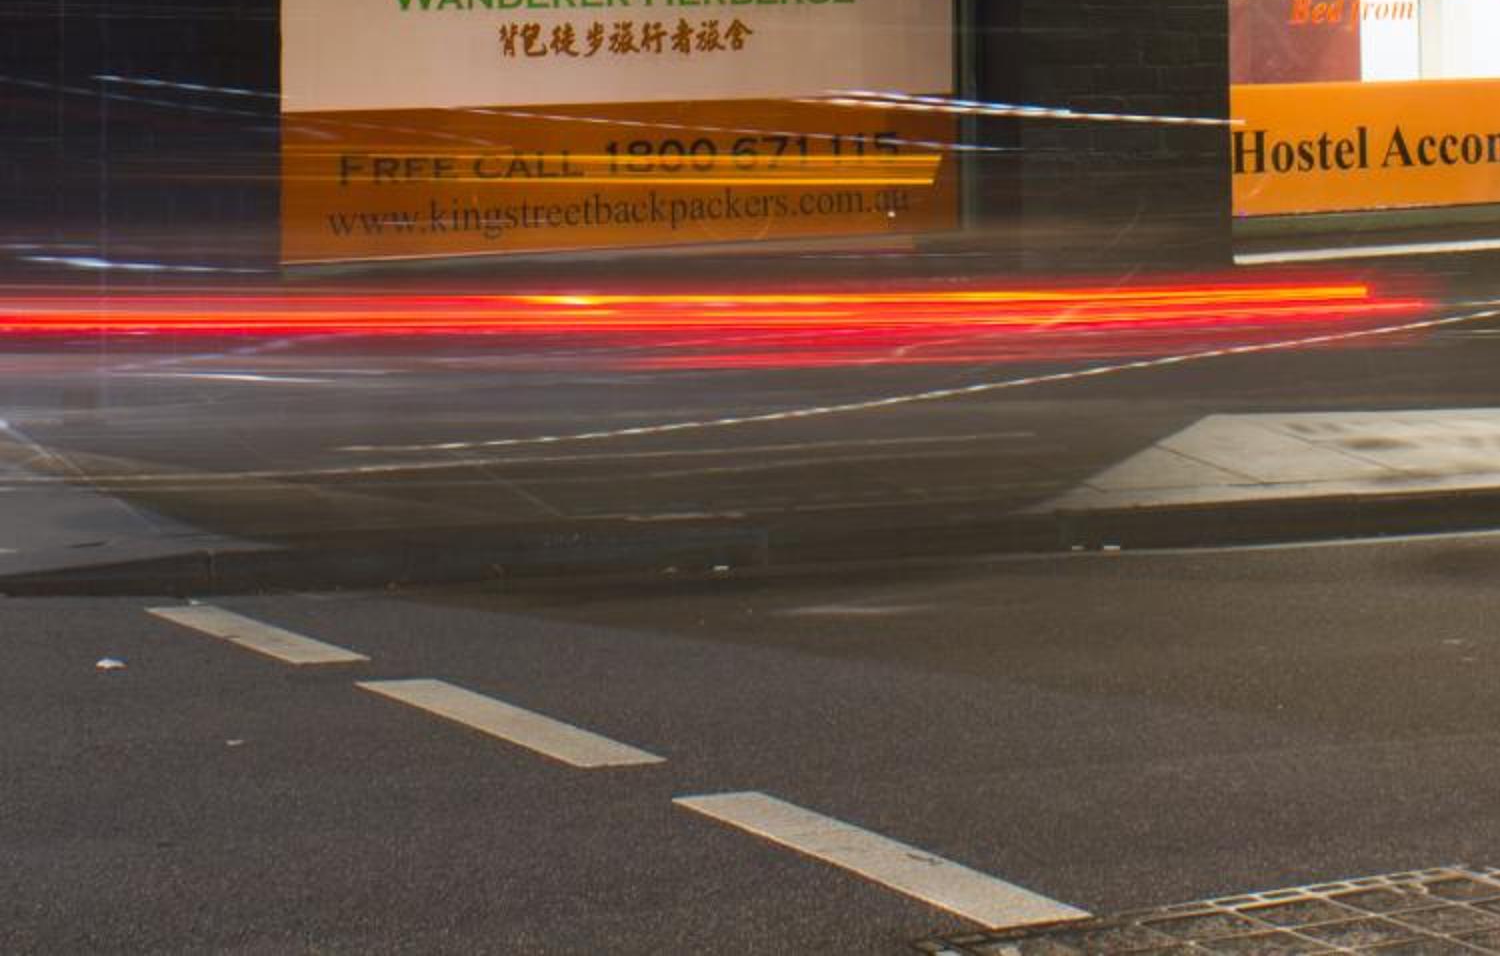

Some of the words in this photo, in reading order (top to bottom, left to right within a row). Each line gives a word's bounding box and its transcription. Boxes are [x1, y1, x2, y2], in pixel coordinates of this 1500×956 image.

[338, 148, 457, 187] FREE
[472, 150, 585, 180] CALL
[606, 138, 717, 173] 1800
[731, 134, 810, 169] 671
[1231, 126, 1368, 174] Hostel
[327, 186, 910, 241] www.kingstreetbackpackers.com.au
